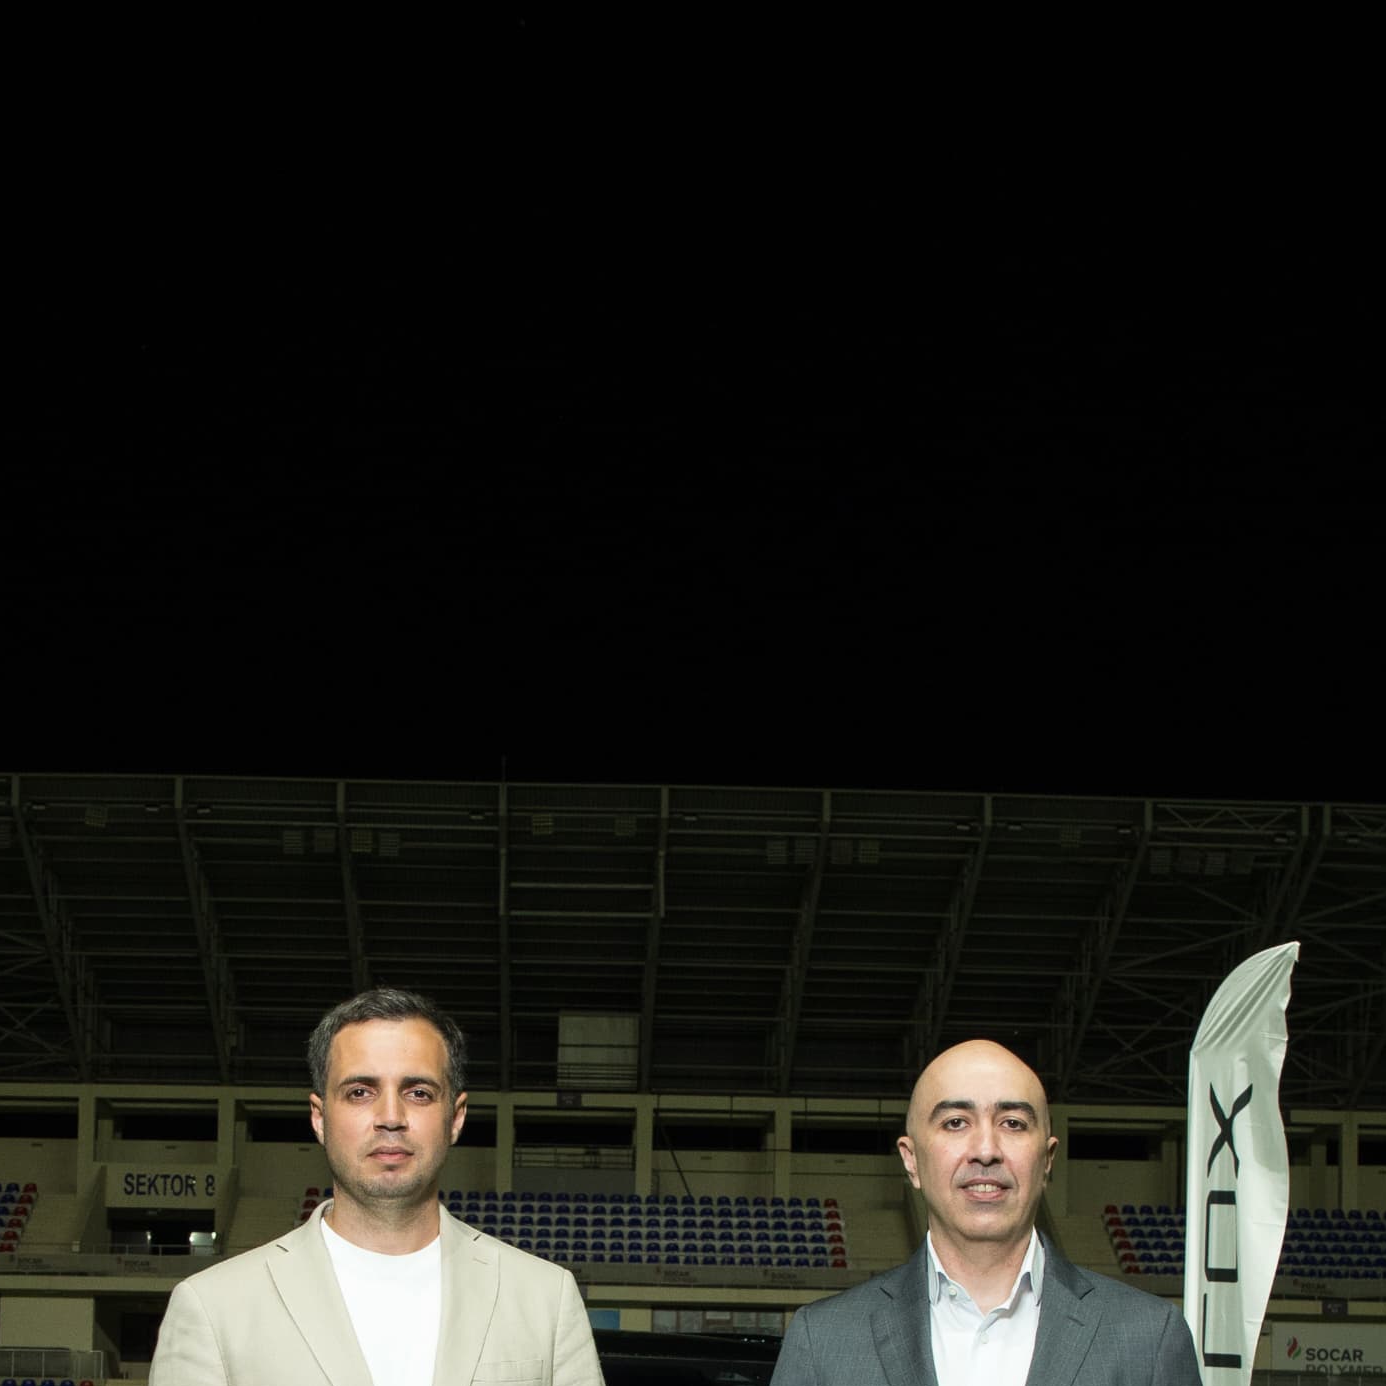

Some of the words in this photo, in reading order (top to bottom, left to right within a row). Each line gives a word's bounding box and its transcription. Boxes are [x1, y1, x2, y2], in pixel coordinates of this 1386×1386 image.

[124, 1173, 196, 1196] SEKTOR
[205, 1174, 215, 1196] 8
[1305, 1348, 1364, 1362] SOCAR
